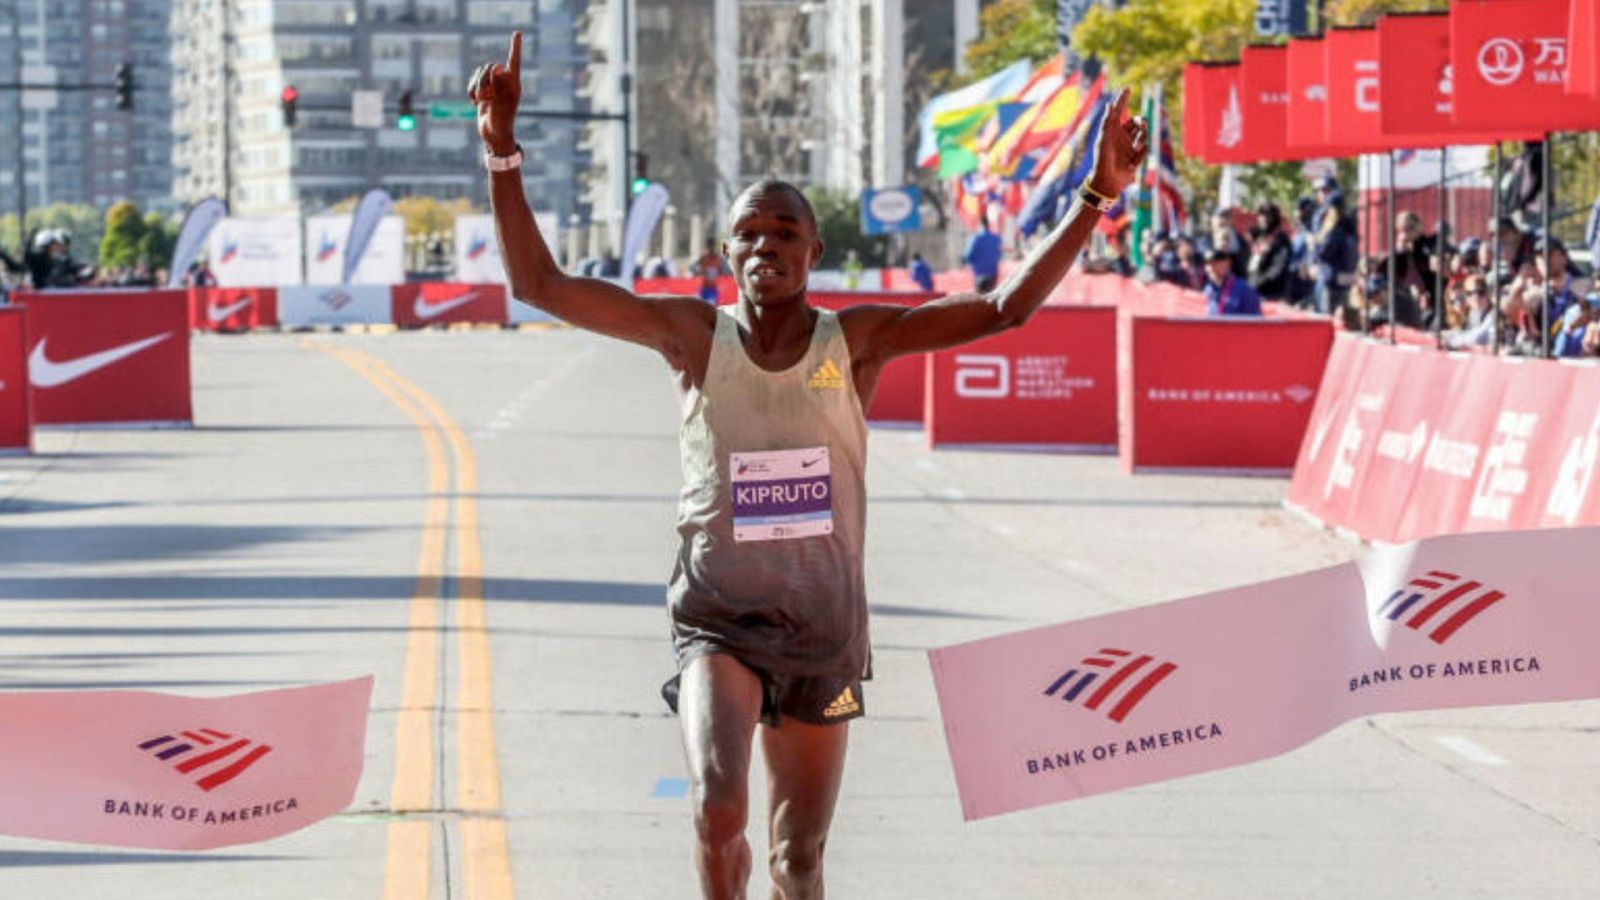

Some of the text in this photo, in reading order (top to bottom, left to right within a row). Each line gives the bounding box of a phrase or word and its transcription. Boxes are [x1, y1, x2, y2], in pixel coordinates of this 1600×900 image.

[1533, 38, 1567, 65] 万
[1148, 388, 1281, 403] BANK OF AMERICA
[737, 481, 828, 505] KIPRUTO
[1349, 657, 1540, 692] BANK OF AMERICA
[1027, 722, 1222, 774] BANK OF AMERICA
[104, 797, 298, 824] BANK OF AMERICA
